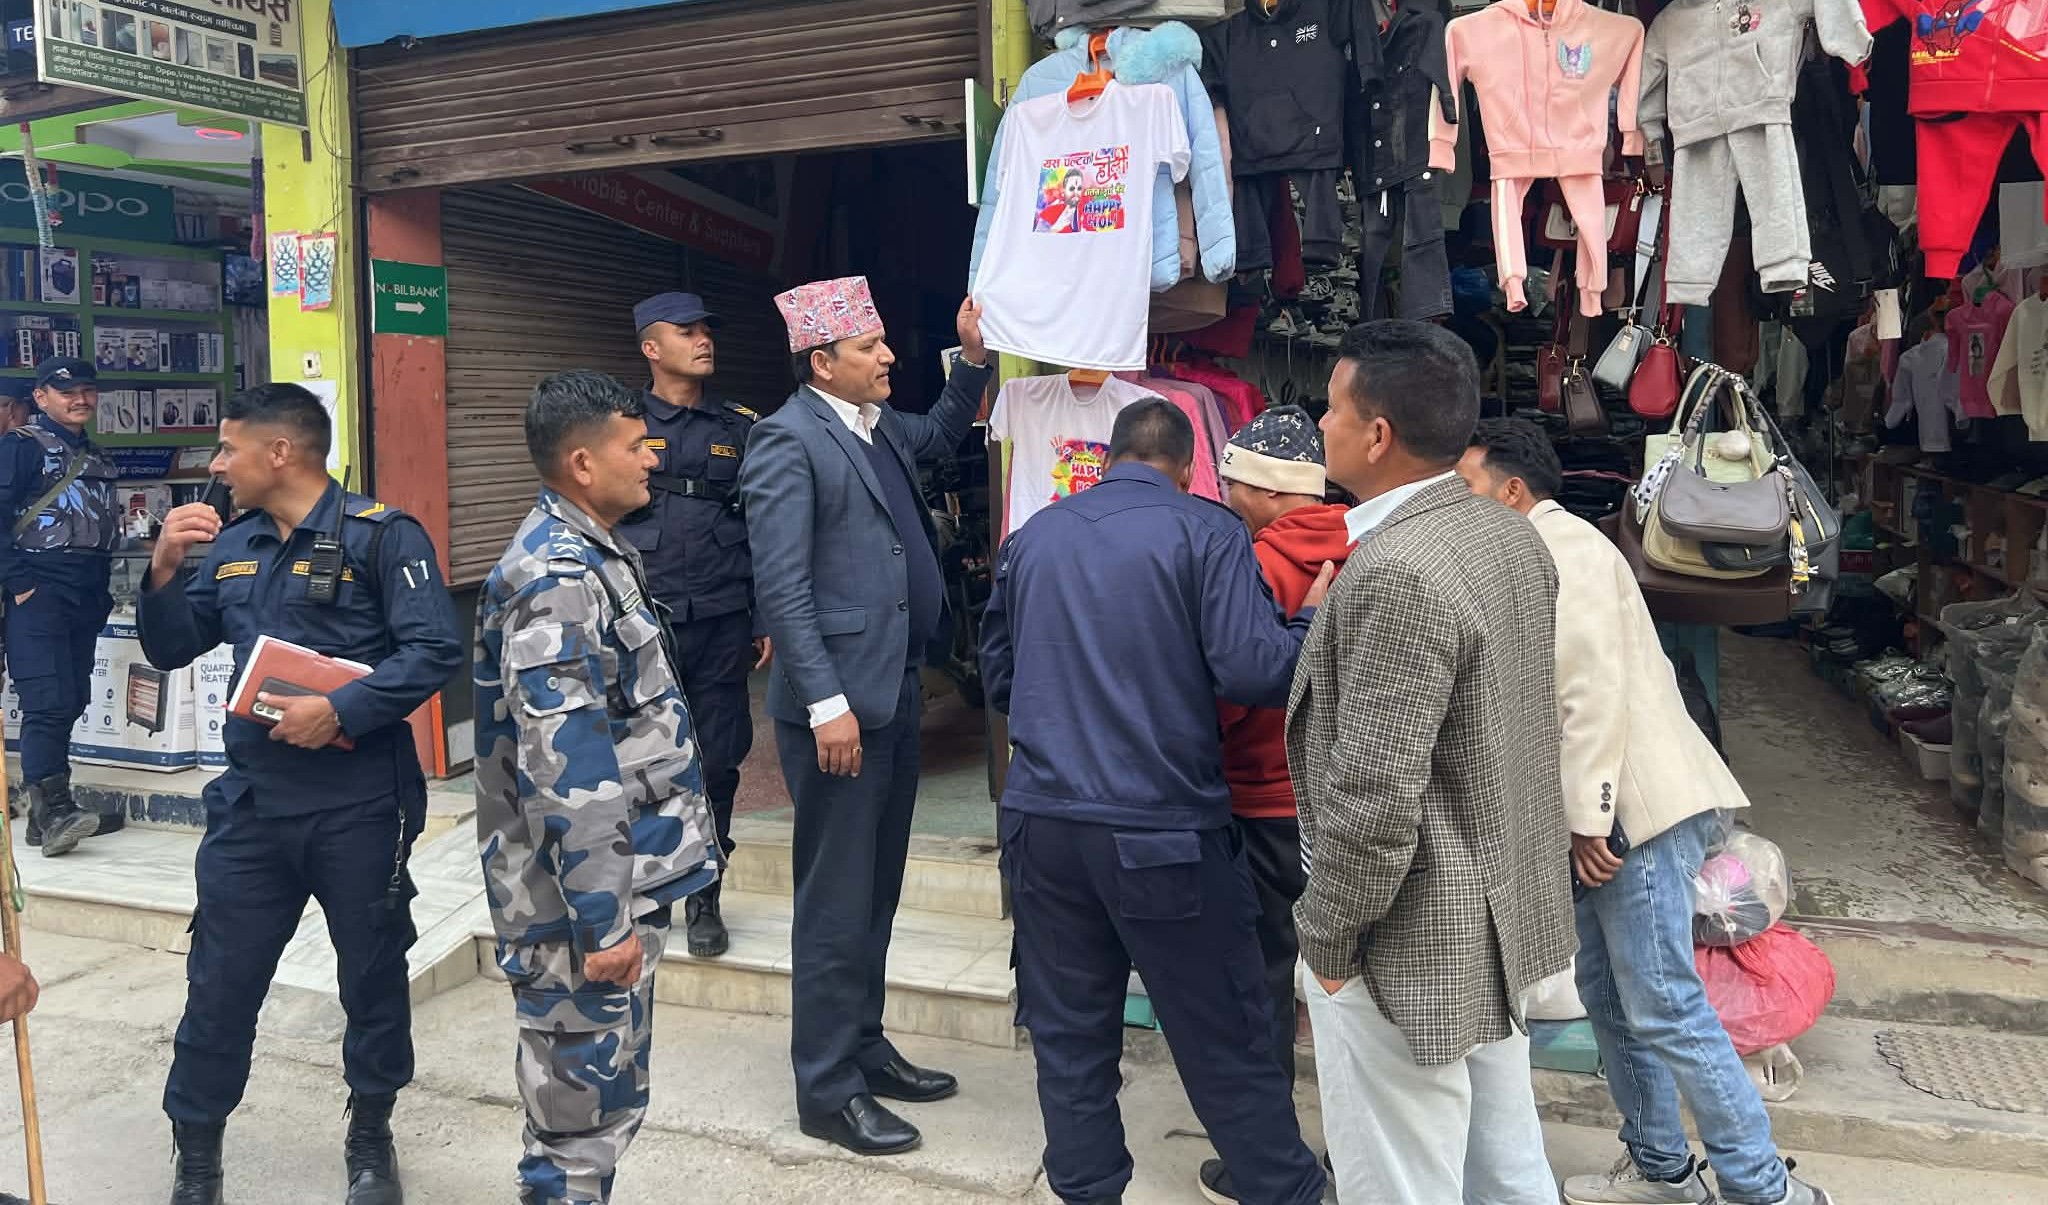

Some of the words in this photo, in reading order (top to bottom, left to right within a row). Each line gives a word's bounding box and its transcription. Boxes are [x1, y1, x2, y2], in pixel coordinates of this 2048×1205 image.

[633, 188, 686, 230] Center
[689, 213, 700, 233] &
[200, 664, 236, 673] QUARTZ
[200, 674, 230, 684] HEATE
